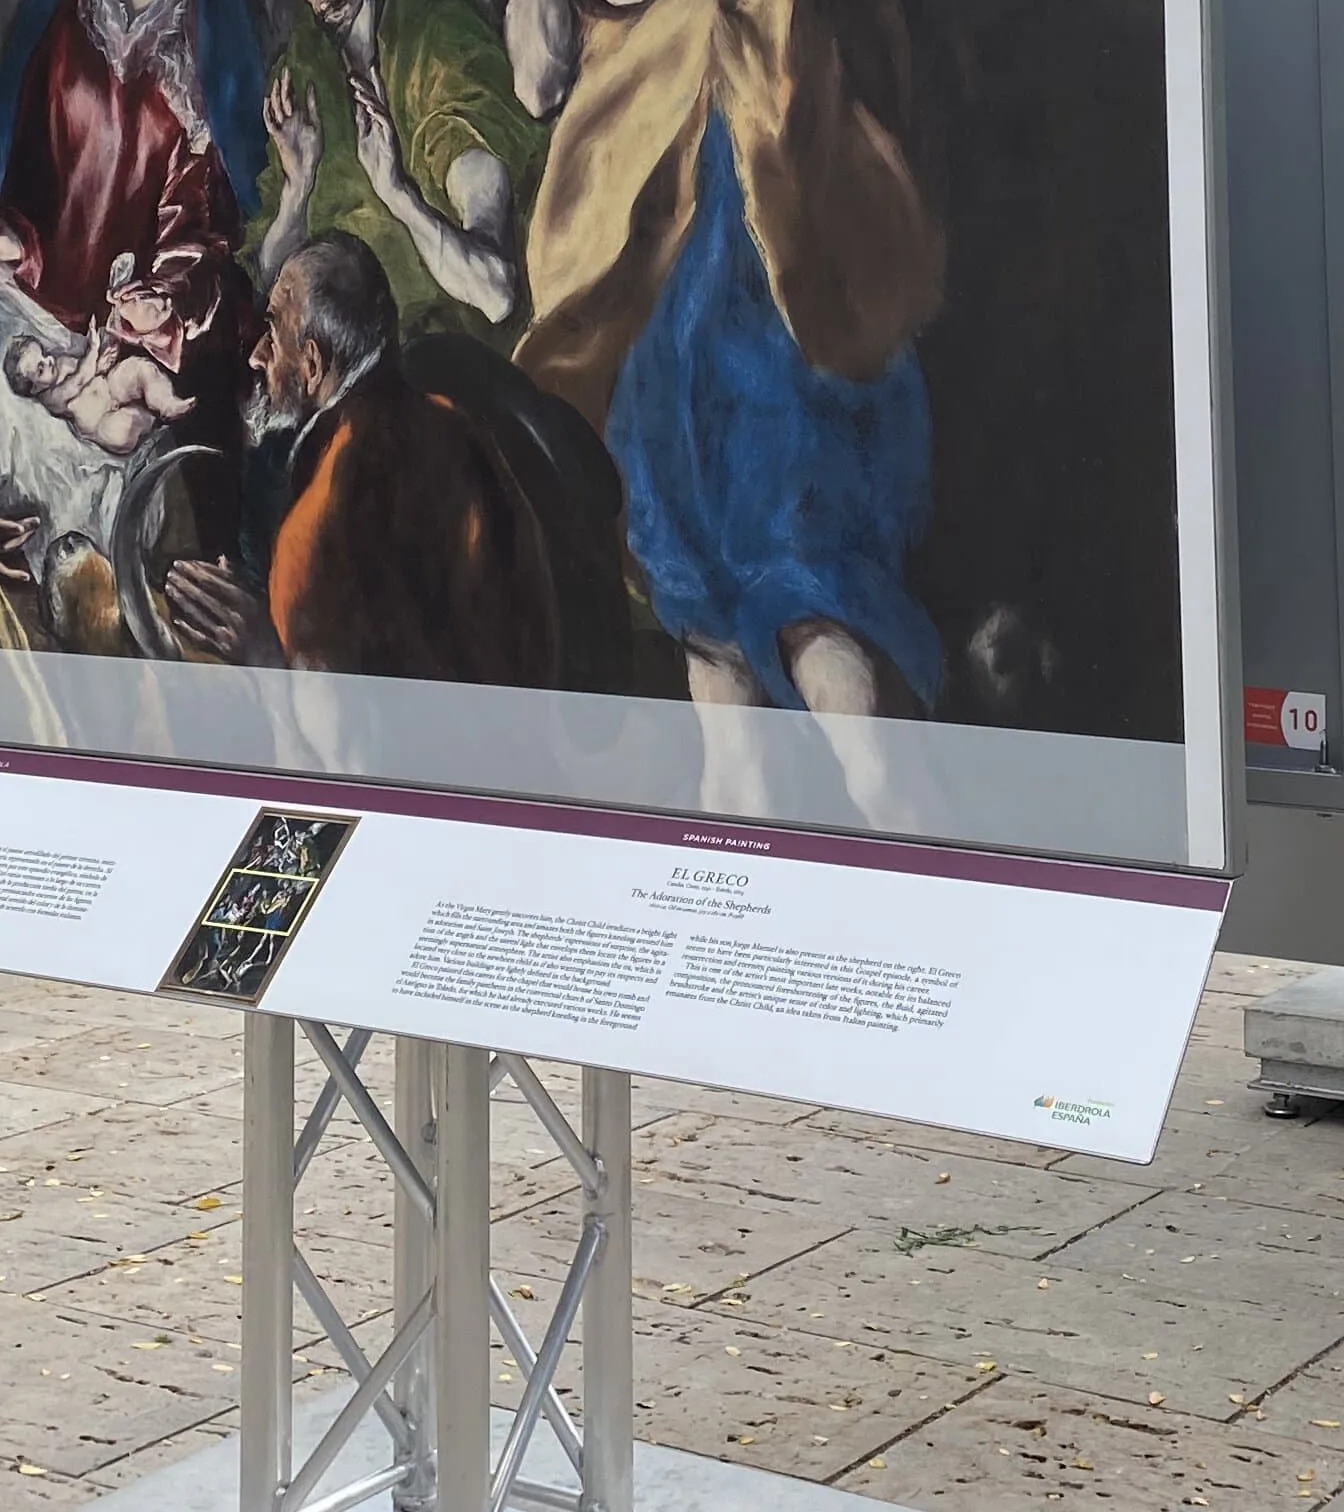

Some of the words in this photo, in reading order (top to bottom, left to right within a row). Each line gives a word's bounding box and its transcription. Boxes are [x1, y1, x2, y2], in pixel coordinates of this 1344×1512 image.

[1289, 708, 1318, 732] 10
[682, 834, 723, 845] SPANISH
[725, 838, 772, 850] PAINTING
[672, 867, 690, 880] EL
[694, 870, 750, 887] GRECO
[631, 888, 648, 899] The
[649, 890, 694, 904] Adoration
[696, 896, 708, 906] of
[708, 898, 723, 909] the
[724, 900, 772, 916] Shepherds
[1052, 1111, 1090, 1126] ESPAÑA
[1054, 1100, 1110, 1118] IBERDROLA
